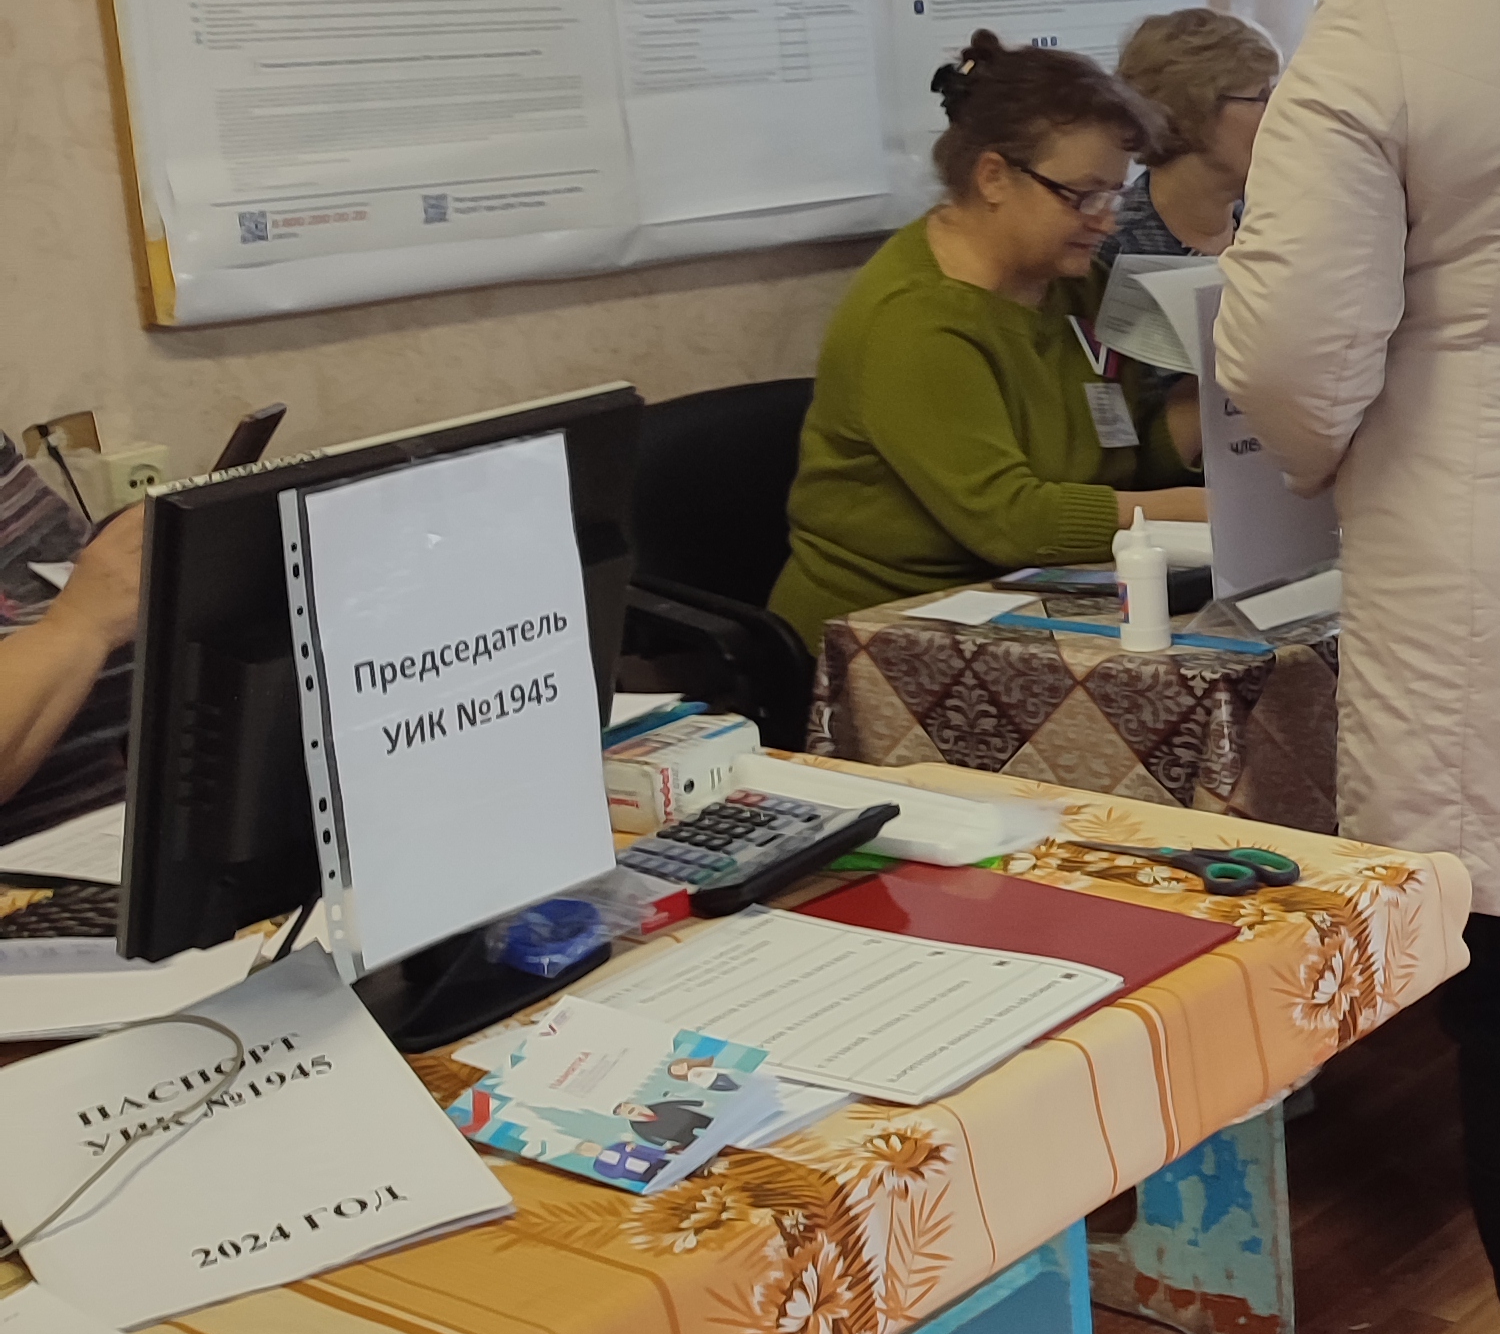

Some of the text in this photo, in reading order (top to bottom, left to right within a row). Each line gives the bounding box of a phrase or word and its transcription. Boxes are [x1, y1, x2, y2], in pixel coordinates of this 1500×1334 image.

[354, 612, 567, 695] Председатель
[382, 673, 558, 755] УИК №1945
[77, 1032, 300, 1128] ПАСПОРТ
[201, 1054, 333, 1118] №1945
[191, 1184, 408, 1269] 2024 ГОД
